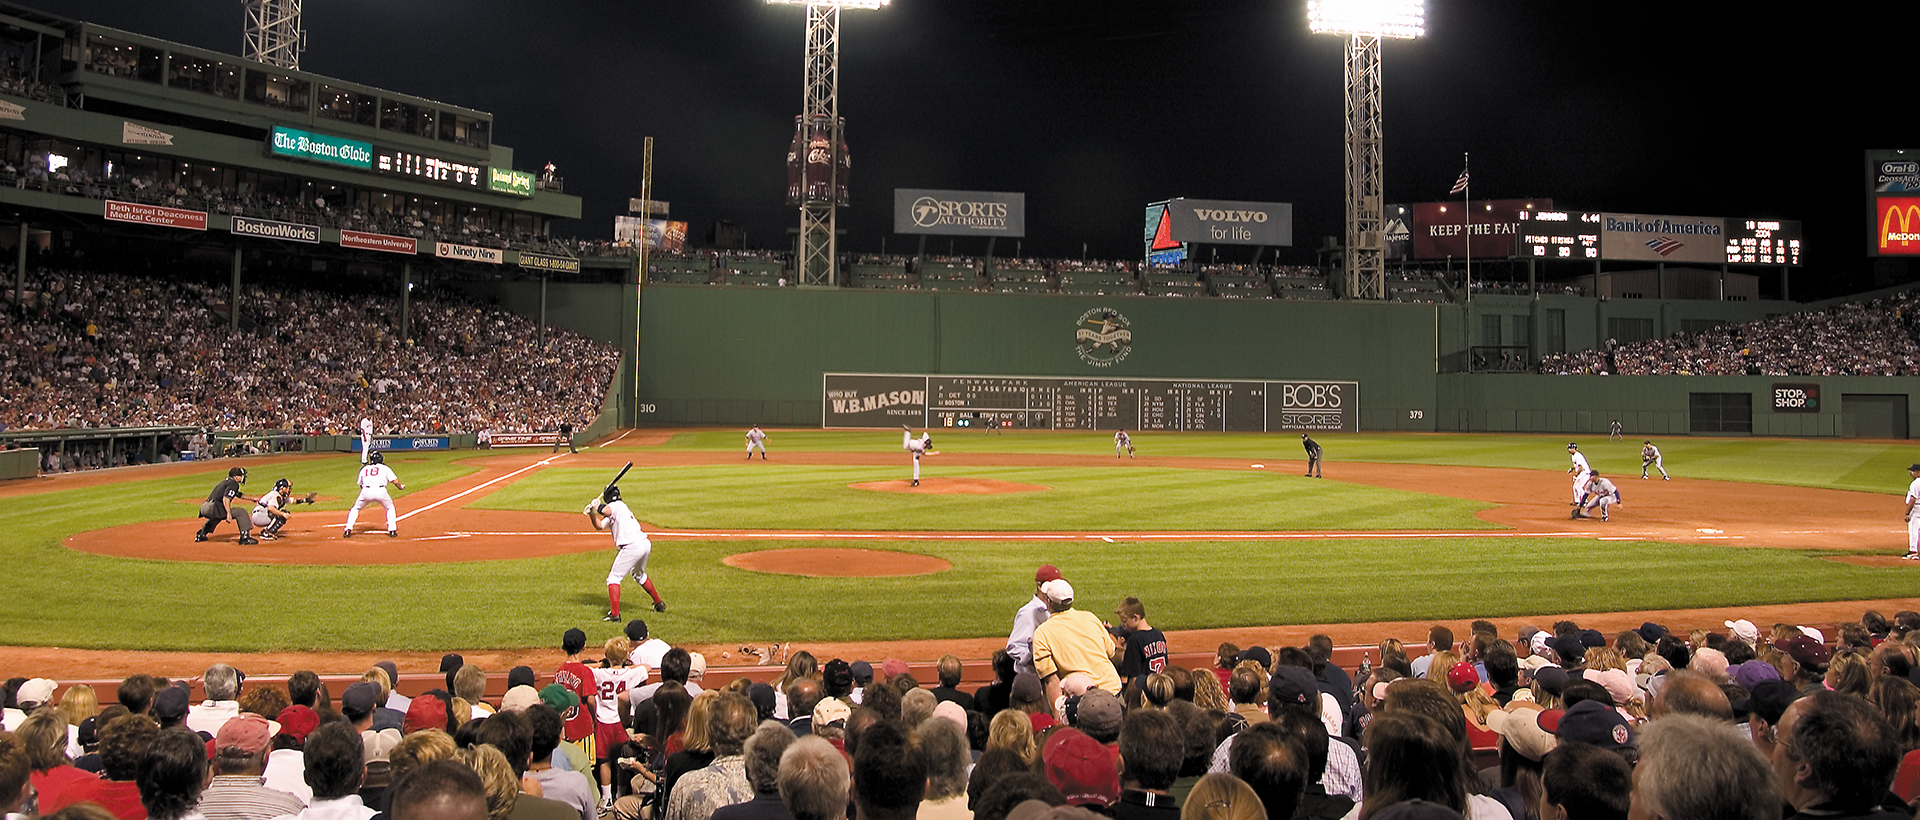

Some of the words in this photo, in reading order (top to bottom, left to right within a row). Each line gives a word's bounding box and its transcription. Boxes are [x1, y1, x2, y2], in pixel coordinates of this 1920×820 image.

[275, 132, 297, 149] The
[298, 136, 338, 157] Boston
[339, 145, 370, 163] Globe
[426, 166, 433, 178] 2
[441, 169, 447, 180] 2
[456, 171, 463, 183] 0
[471, 174, 477, 186] 2
[110, 204, 130, 213] Beth
[132, 206, 155, 217] Israel
[157, 209, 204, 222] Deaconess
[939, 201, 1007, 218] SPORTS
[1194, 209, 1268, 223] VOLVO
[110, 211, 143, 221] Medical
[145, 215, 174, 225] Center
[938, 216, 1006, 226] AUTHORITY
[236, 218, 316, 241] BostonWorks
[1211, 226, 1228, 239] for
[1232, 227, 1252, 241] life
[1430, 225, 1462, 236] KEEP
[1465, 223, 1490, 234] THE
[1494, 222, 1520, 234] FAI
[1605, 217, 1643, 232] Bank
[1644, 218, 1660, 232] of
[1660, 218, 1721, 236] America
[342, 234, 382, 246] Northeastern
[383, 237, 413, 251] University
[453, 245, 478, 260] Ninety
[479, 248, 496, 260] Nine
[534, 257, 548, 268] GLASS
[1076, 307, 1102, 326] BOSTON
[1118, 313, 1132, 327] SOX
[1087, 360, 1113, 368] JIMMY
[1115, 346, 1133, 364] FUND
[1283, 384, 1341, 408] BOB'S
[1775, 389, 1803, 398] STOP
[640, 403, 656, 413] 310
[1409, 410, 1423, 419] 379
[944, 417, 954, 427] 18
[1282, 414, 1341, 425] STORES
[365, 467, 380, 477] 18
[601, 680, 626, 701] 24
